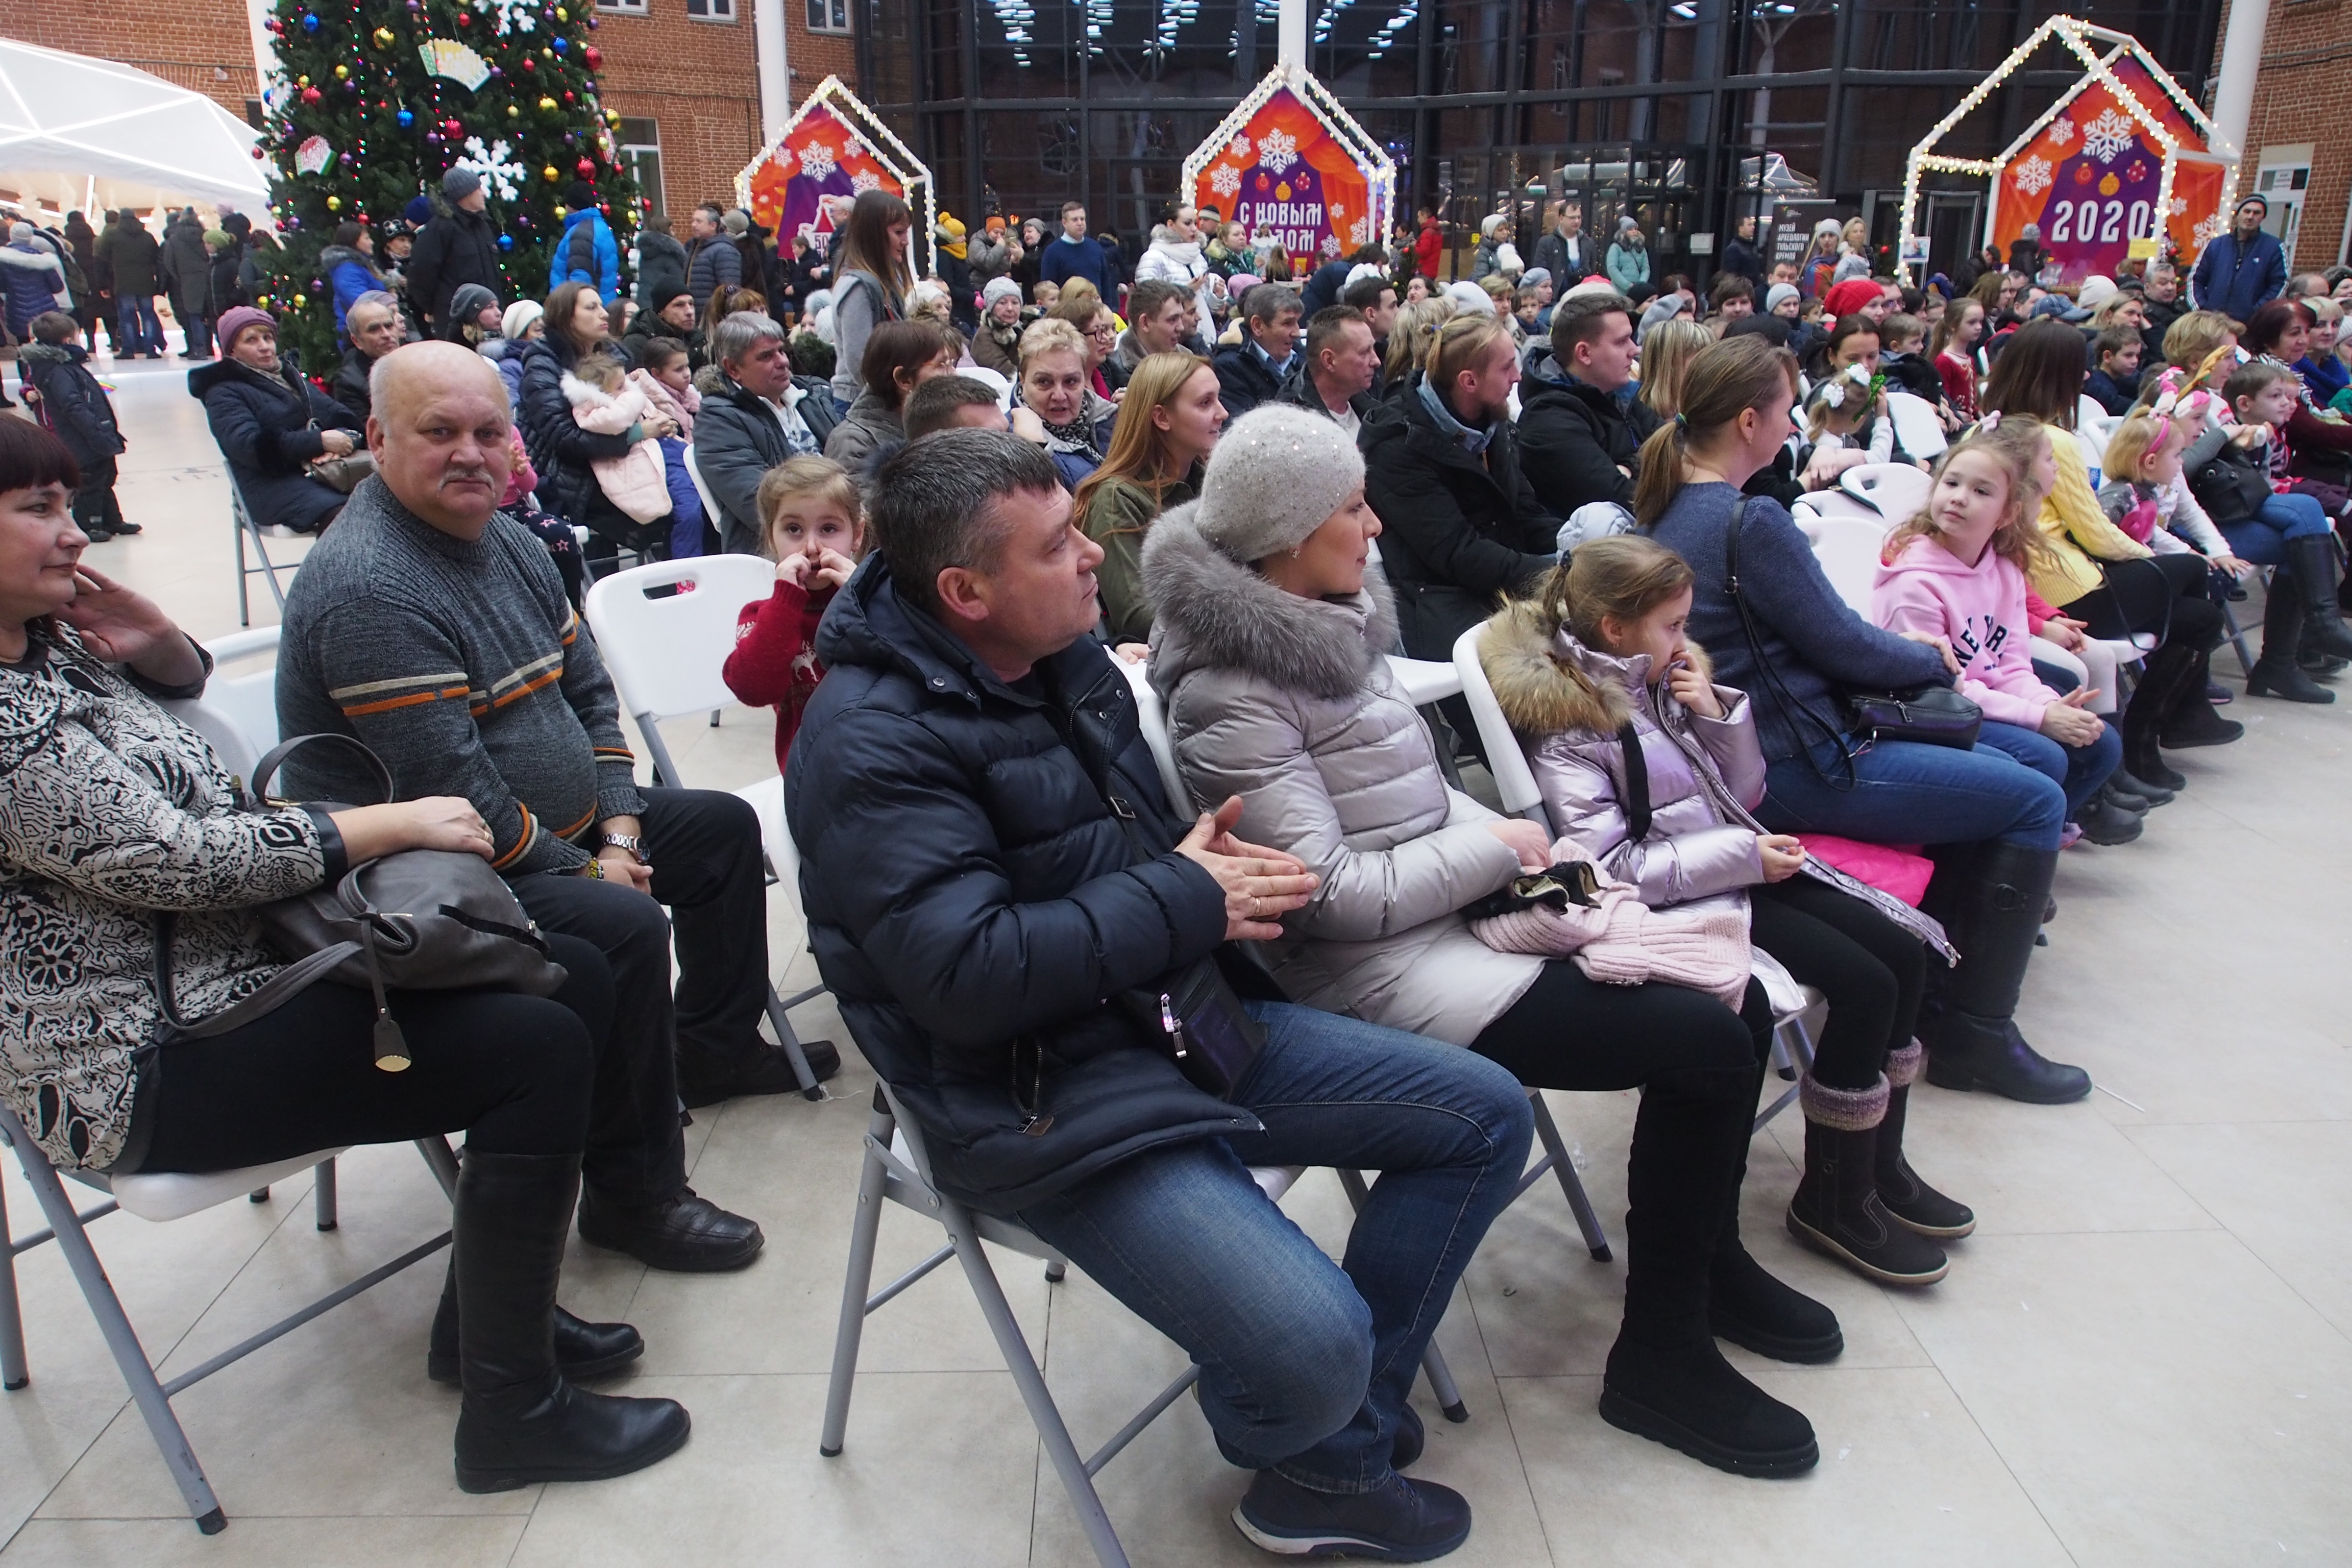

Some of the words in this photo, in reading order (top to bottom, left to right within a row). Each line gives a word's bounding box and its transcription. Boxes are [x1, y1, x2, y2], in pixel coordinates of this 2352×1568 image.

[1240, 202, 1250, 225] С
[1256, 202, 1322, 225] НОВЫМ
[2052, 200, 2150, 242] 2020
[1779, 222, 1796, 232] МУЗЕЙ
[1777, 233, 1809, 241] АРХЕОЛОГИИ
[1777, 242, 1804, 251] ТУЛЬСКОГО
[1776, 252, 1796, 260] КРЕМЛЯ
